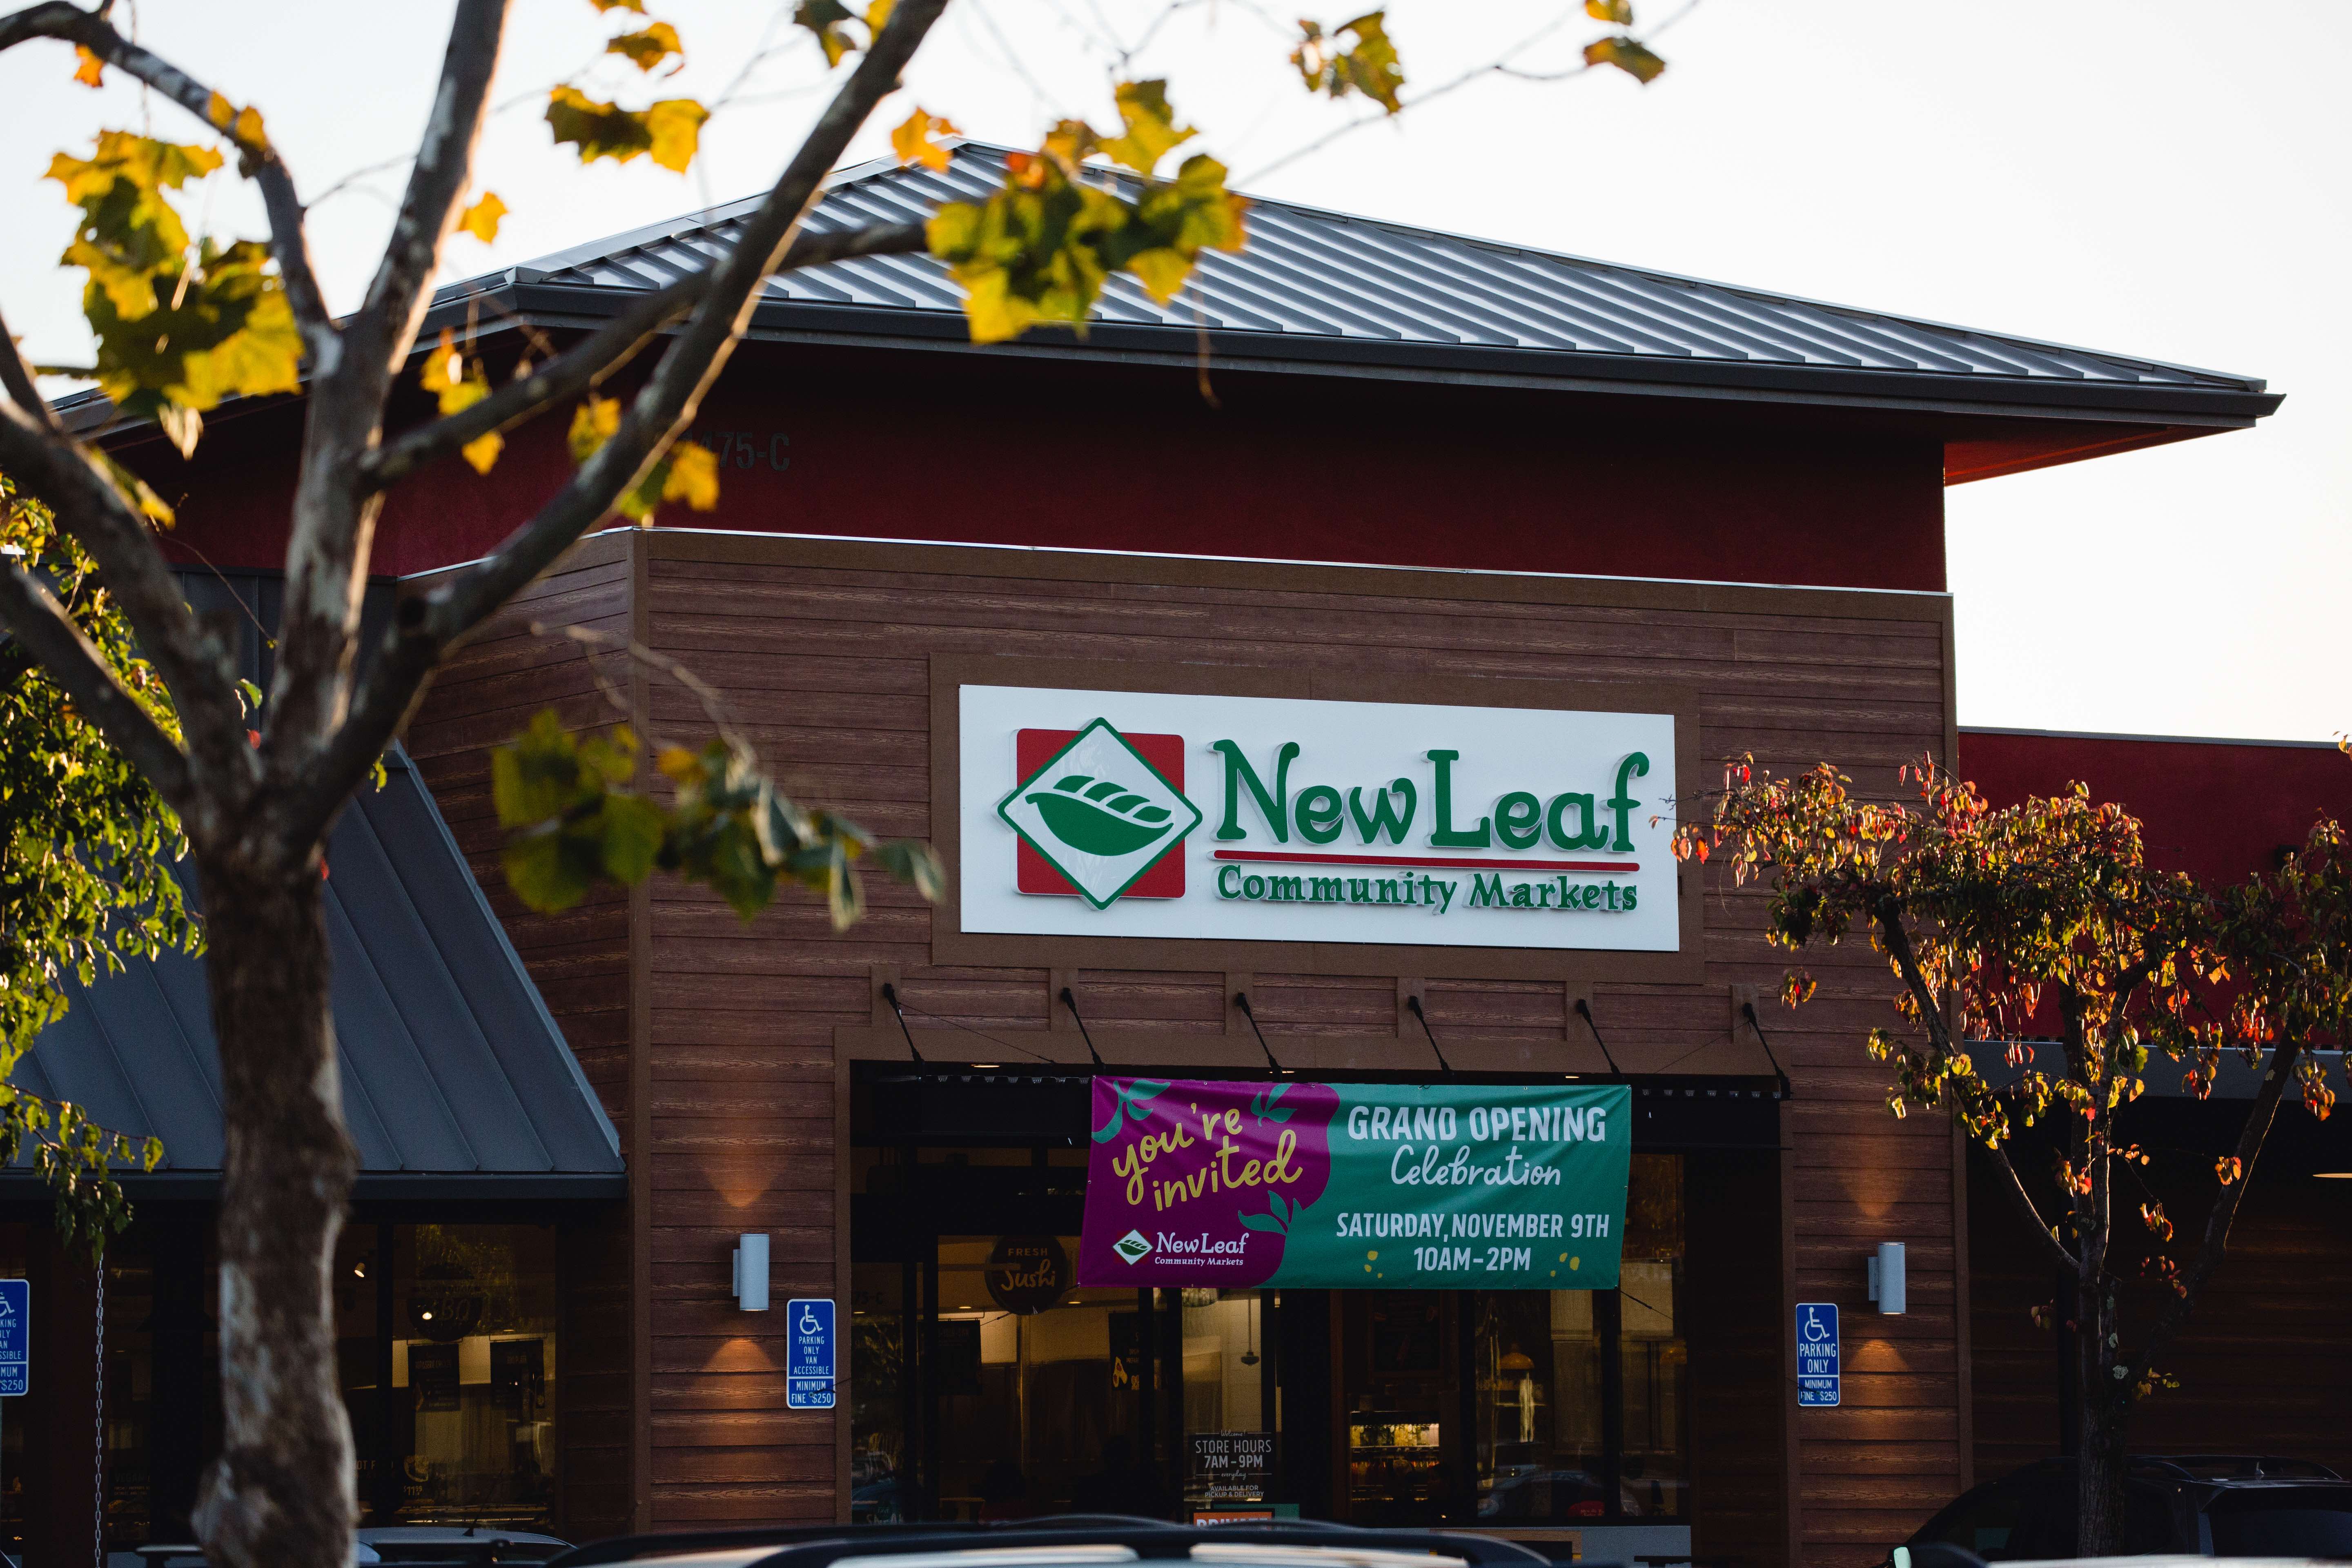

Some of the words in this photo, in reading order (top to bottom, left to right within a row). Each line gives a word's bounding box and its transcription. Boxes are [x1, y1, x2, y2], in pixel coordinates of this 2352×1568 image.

[1218, 865, 1457, 914] Community
[1470, 874, 1637, 911] Markets
[1348, 1106, 1457, 1141] GRAND
[1474, 1107, 1606, 1142] OPENING
[1112, 1102, 1243, 1205] you're
[1152, 1129, 1303, 1211] invited
[1391, 1145, 1561, 1186] Celebration
[1571, 1214, 1609, 1238] 9TH
[1008, 1248, 1048, 1256] FRESH
[1155, 1257, 1205, 1266] Community
[799, 1336, 824, 1344] PARKING
[804, 1346, 819, 1354] ONLY
[1800, 1343, 1836, 1357] PARKING
[806, 1356, 817, 1365] VAN
[1808, 1359, 1829, 1373] ONLY
[793, 1366, 829, 1374] ACCESSIBLE
[1, 1379, 23, 1391] $250
[796, 1381, 826, 1391] MINIMUM
[1805, 1379, 1832, 1389] MINIMUM
[792, 1393, 806, 1403] FINE
[812, 1393, 831, 1404] $250
[1820, 1391, 1836, 1401] $250
[1196, 1440, 1229, 1453] STORE
[1234, 1440, 1272, 1453] HOURS
[1205, 1455, 1228, 1468] 7AM
[1239, 1455, 1263, 1468] 9PM
[1221, 1470, 1246, 1480] everyday
